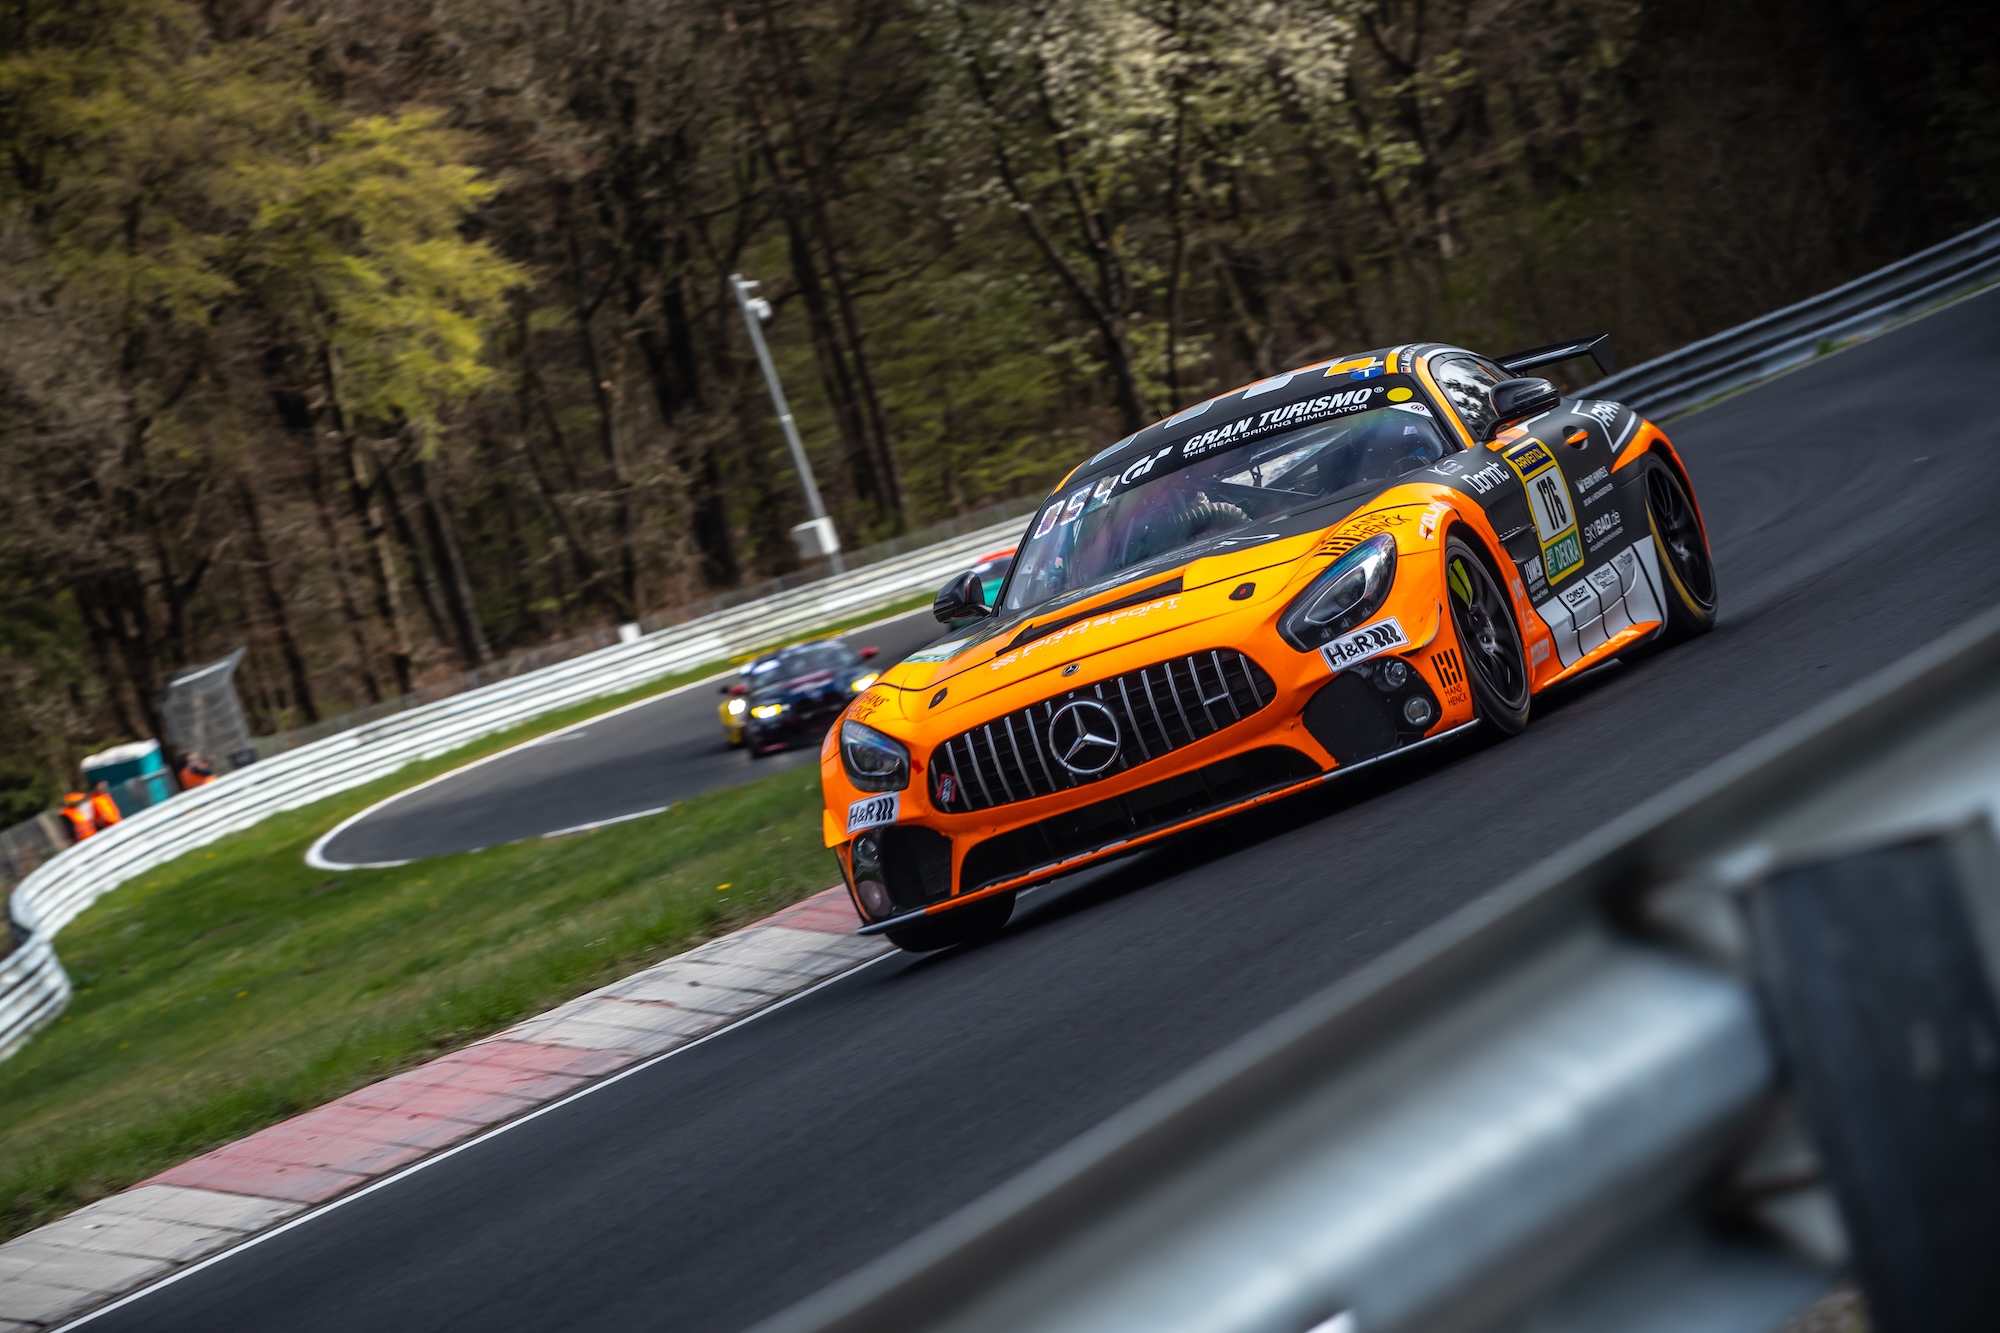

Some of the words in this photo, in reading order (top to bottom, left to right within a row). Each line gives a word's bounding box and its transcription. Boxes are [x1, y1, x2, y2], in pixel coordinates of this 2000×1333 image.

[1183, 416, 1254, 453] GRAN
[1258, 388, 1373, 427] TURISMO
[1183, 446, 1206, 459] THE
[1208, 436, 1239, 450] REAL
[1242, 419, 1292, 438] DRIVING
[1294, 403, 1368, 424] SIMULATOR
[1513, 447, 1547, 469] RAVENOL
[1536, 475, 1567, 531] 176
[1337, 513, 1386, 536] HANS
[1353, 514, 1412, 539] HENCK
[1554, 536, 1581, 571] DEKRA
[1324, 635, 1374, 665] H&R
[1444, 683, 1463, 698] HANS
[1447, 691, 1469, 707] HENCK
[848, 801, 875, 828] H&R
